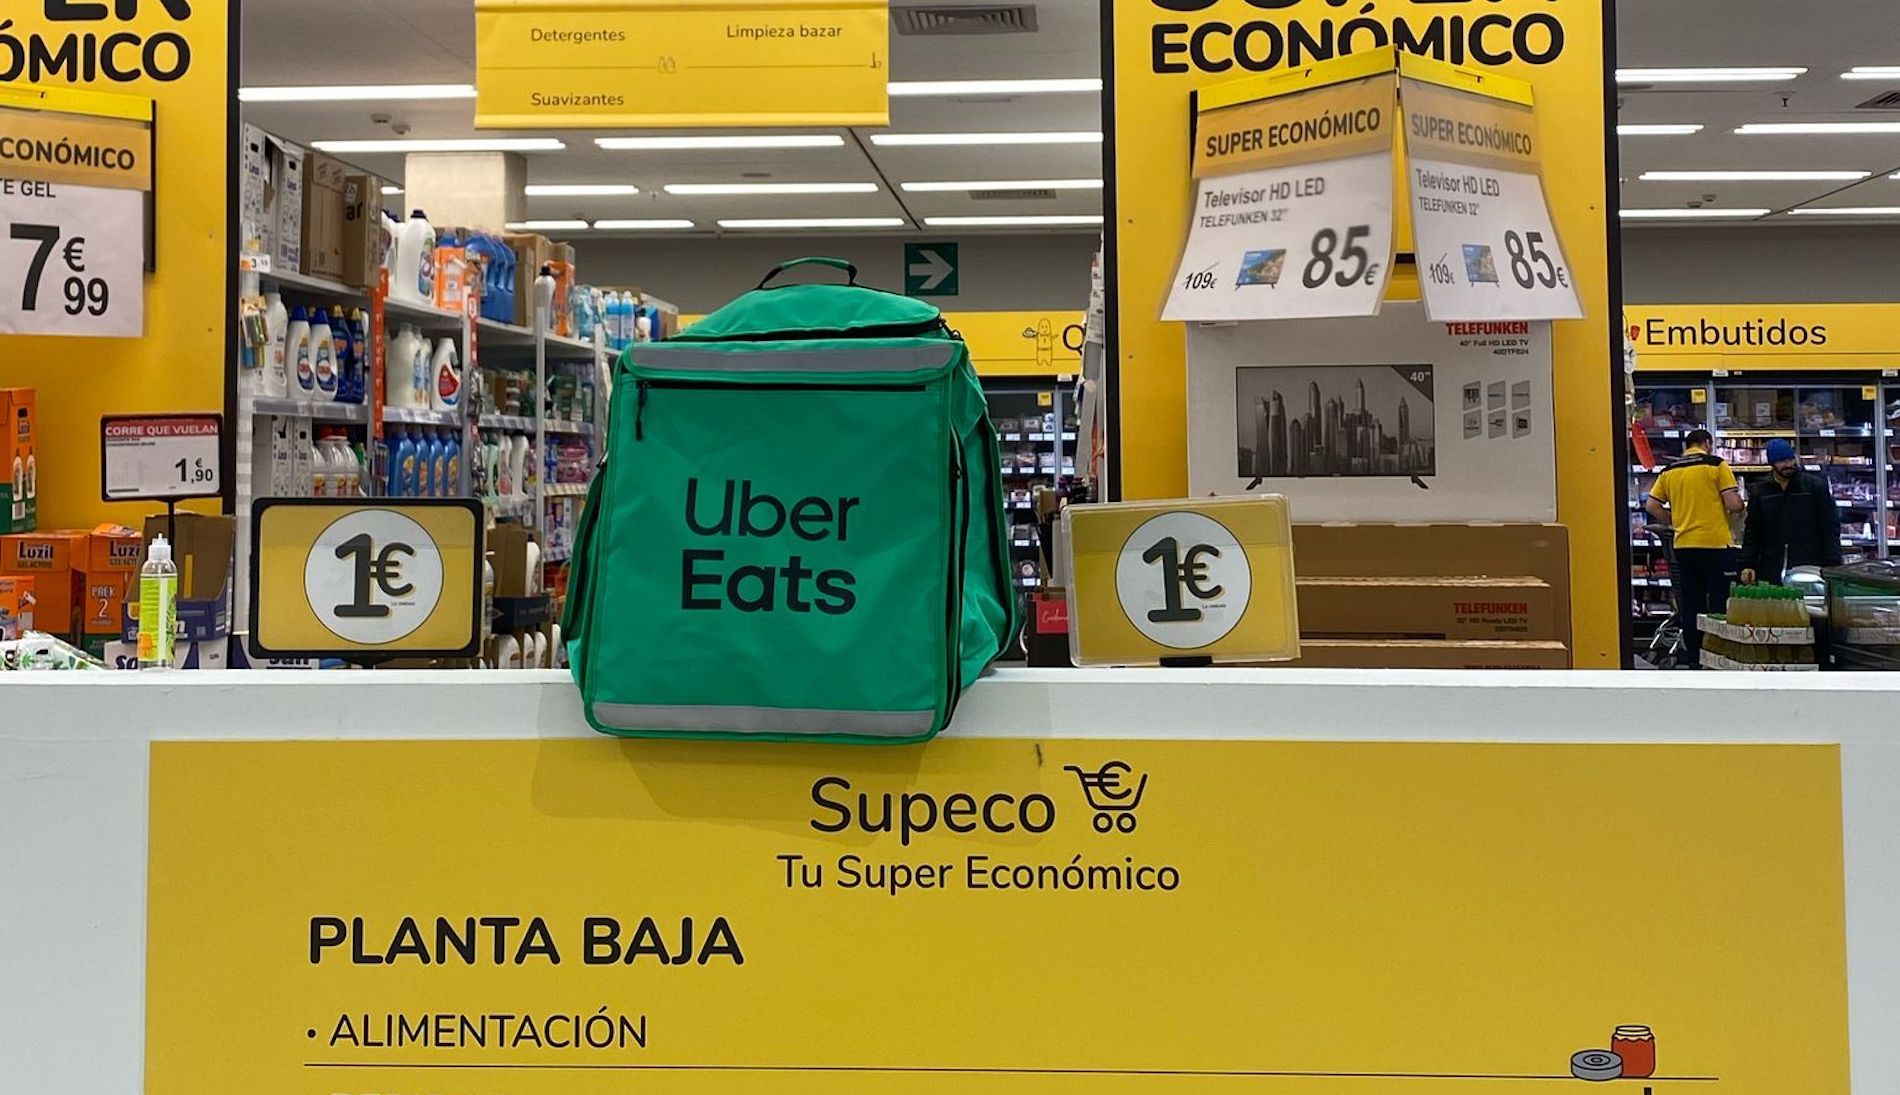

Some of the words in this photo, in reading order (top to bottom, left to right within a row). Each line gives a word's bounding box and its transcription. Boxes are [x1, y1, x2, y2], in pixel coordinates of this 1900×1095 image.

[530, 28, 626, 44] Detergentes
[726, 24, 795, 39] Limpieza
[800, 24, 843, 37] bazar
[1151, 3, 1565, 74] ECONÓMICO
[531, 92, 624, 106] Suavizantes
[1206, 128, 1263, 158] SUPER
[1268, 107, 1380, 148] ECONÓMICO
[1411, 114, 1455, 142] SUPER
[1458, 121, 1532, 155] ECONÓMICO
[20, 180, 56, 198] GEL
[1204, 187, 1266, 209] Televisor
[1269, 181, 1291, 201] HD
[1295, 177, 1326, 198] LED
[1416, 168, 1461, 193] Televisor
[1462, 175, 1478, 194] HD
[1480, 178, 1500, 197] LED
[1419, 196, 1468, 215] TELEFUNKEN
[1200, 210, 1268, 228] TELEFUNKEN
[10, 222, 61, 311] 7
[64, 276, 109, 316] 99
[1446, 321, 1529, 336] TELEFUNKEN
[1646, 318, 1827, 346] Embutidos
[1410, 371, 1431, 382] 40"
[105, 427, 144, 436] CORRE
[146, 426, 171, 435] QUE
[172, 424, 218, 434] VUELAN
[685, 477, 860, 541] Uber
[18, 541, 54, 559] Luzil
[109, 540, 140, 558] Luzi
[681, 549, 857, 615] Eats
[98, 597, 108, 618] 2
[1453, 602, 1528, 614] TELEFUNKEN
[810, 776, 1056, 846] Supeco
[777, 855, 823, 889] Tu
[837, 855, 953, 896] Super
[966, 853, 1181, 891] Económico
[310, 917, 561, 965] PLANTA
[583, 917, 744, 965] BAJA
[329, 1006, 647, 1048] ALIMENTACIÓN
